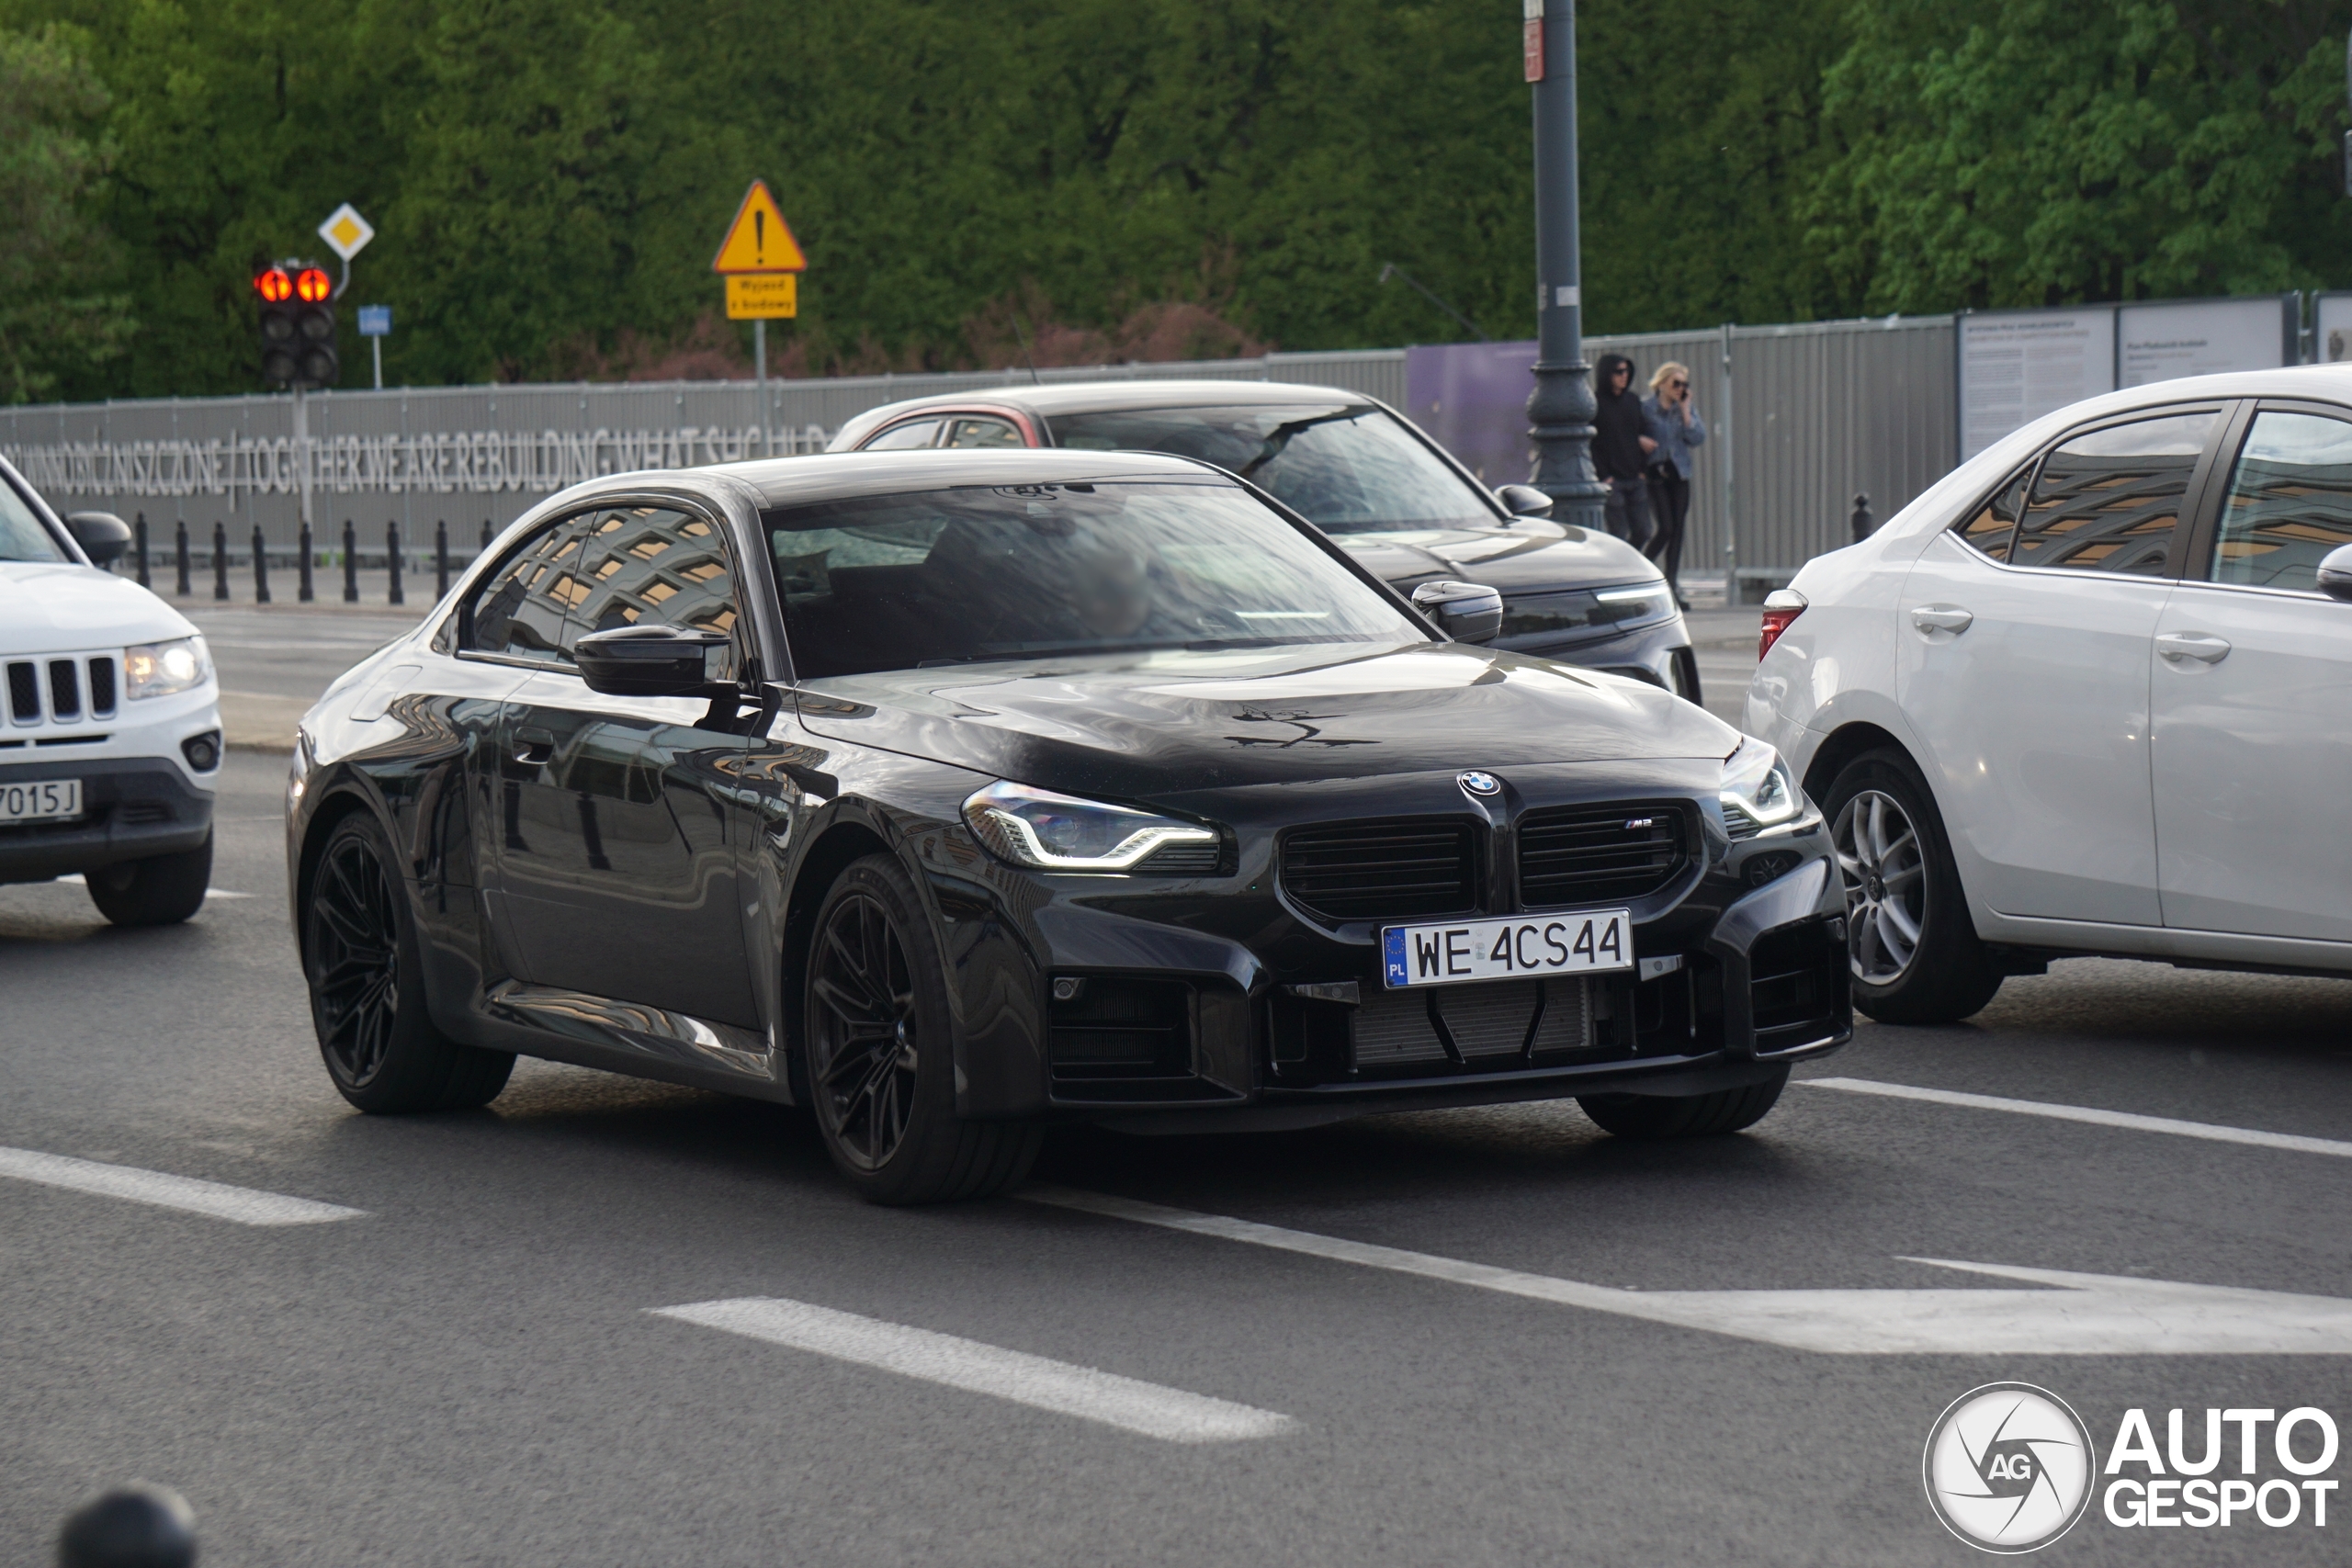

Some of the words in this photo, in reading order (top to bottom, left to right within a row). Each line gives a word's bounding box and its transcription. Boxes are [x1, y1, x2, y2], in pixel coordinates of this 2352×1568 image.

[367, 434, 401, 493] WE
[405, 432, 453, 493] ARE
[457, 429, 611, 492] REBUILDING
[1389, 963, 1405, 976] PL
[1415, 929, 1472, 977] WE
[1489, 917, 1622, 969] 4CS44
